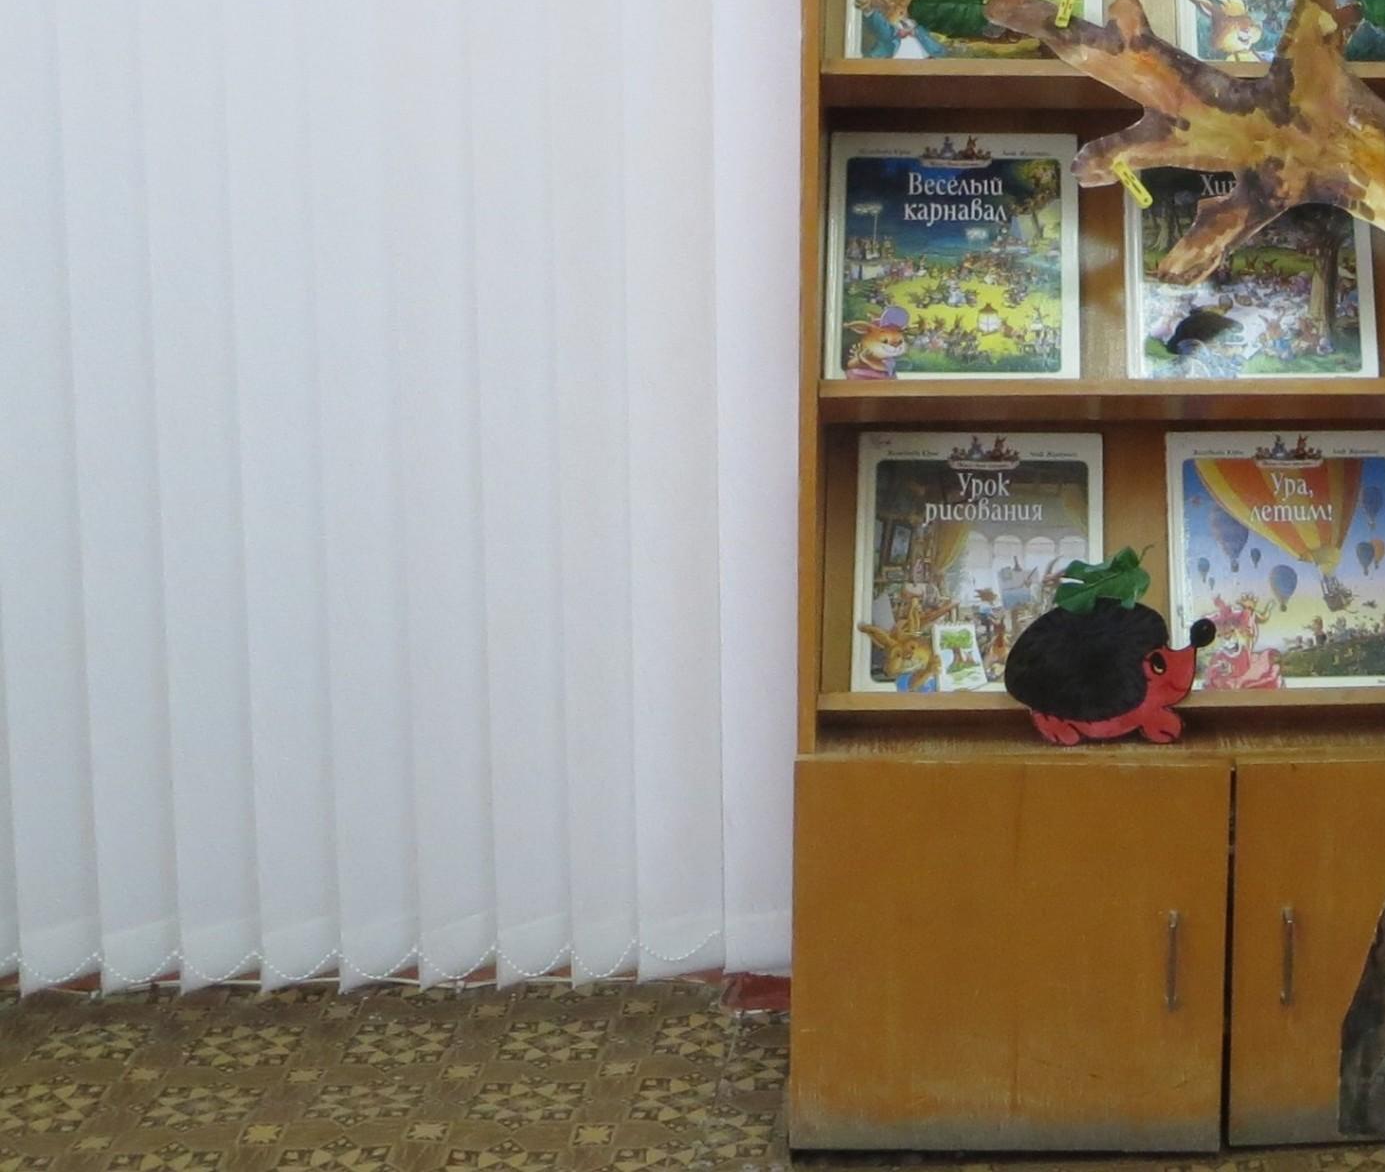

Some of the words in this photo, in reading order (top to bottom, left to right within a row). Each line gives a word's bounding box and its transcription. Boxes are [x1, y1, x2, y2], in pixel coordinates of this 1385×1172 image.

[904, 198, 1007, 226] карнавал
[957, 473, 1011, 502] Урок
[1271, 473, 1314, 502] Ура,
[922, 498, 1043, 527] рисования
[1251, 502, 1333, 521] летим!
